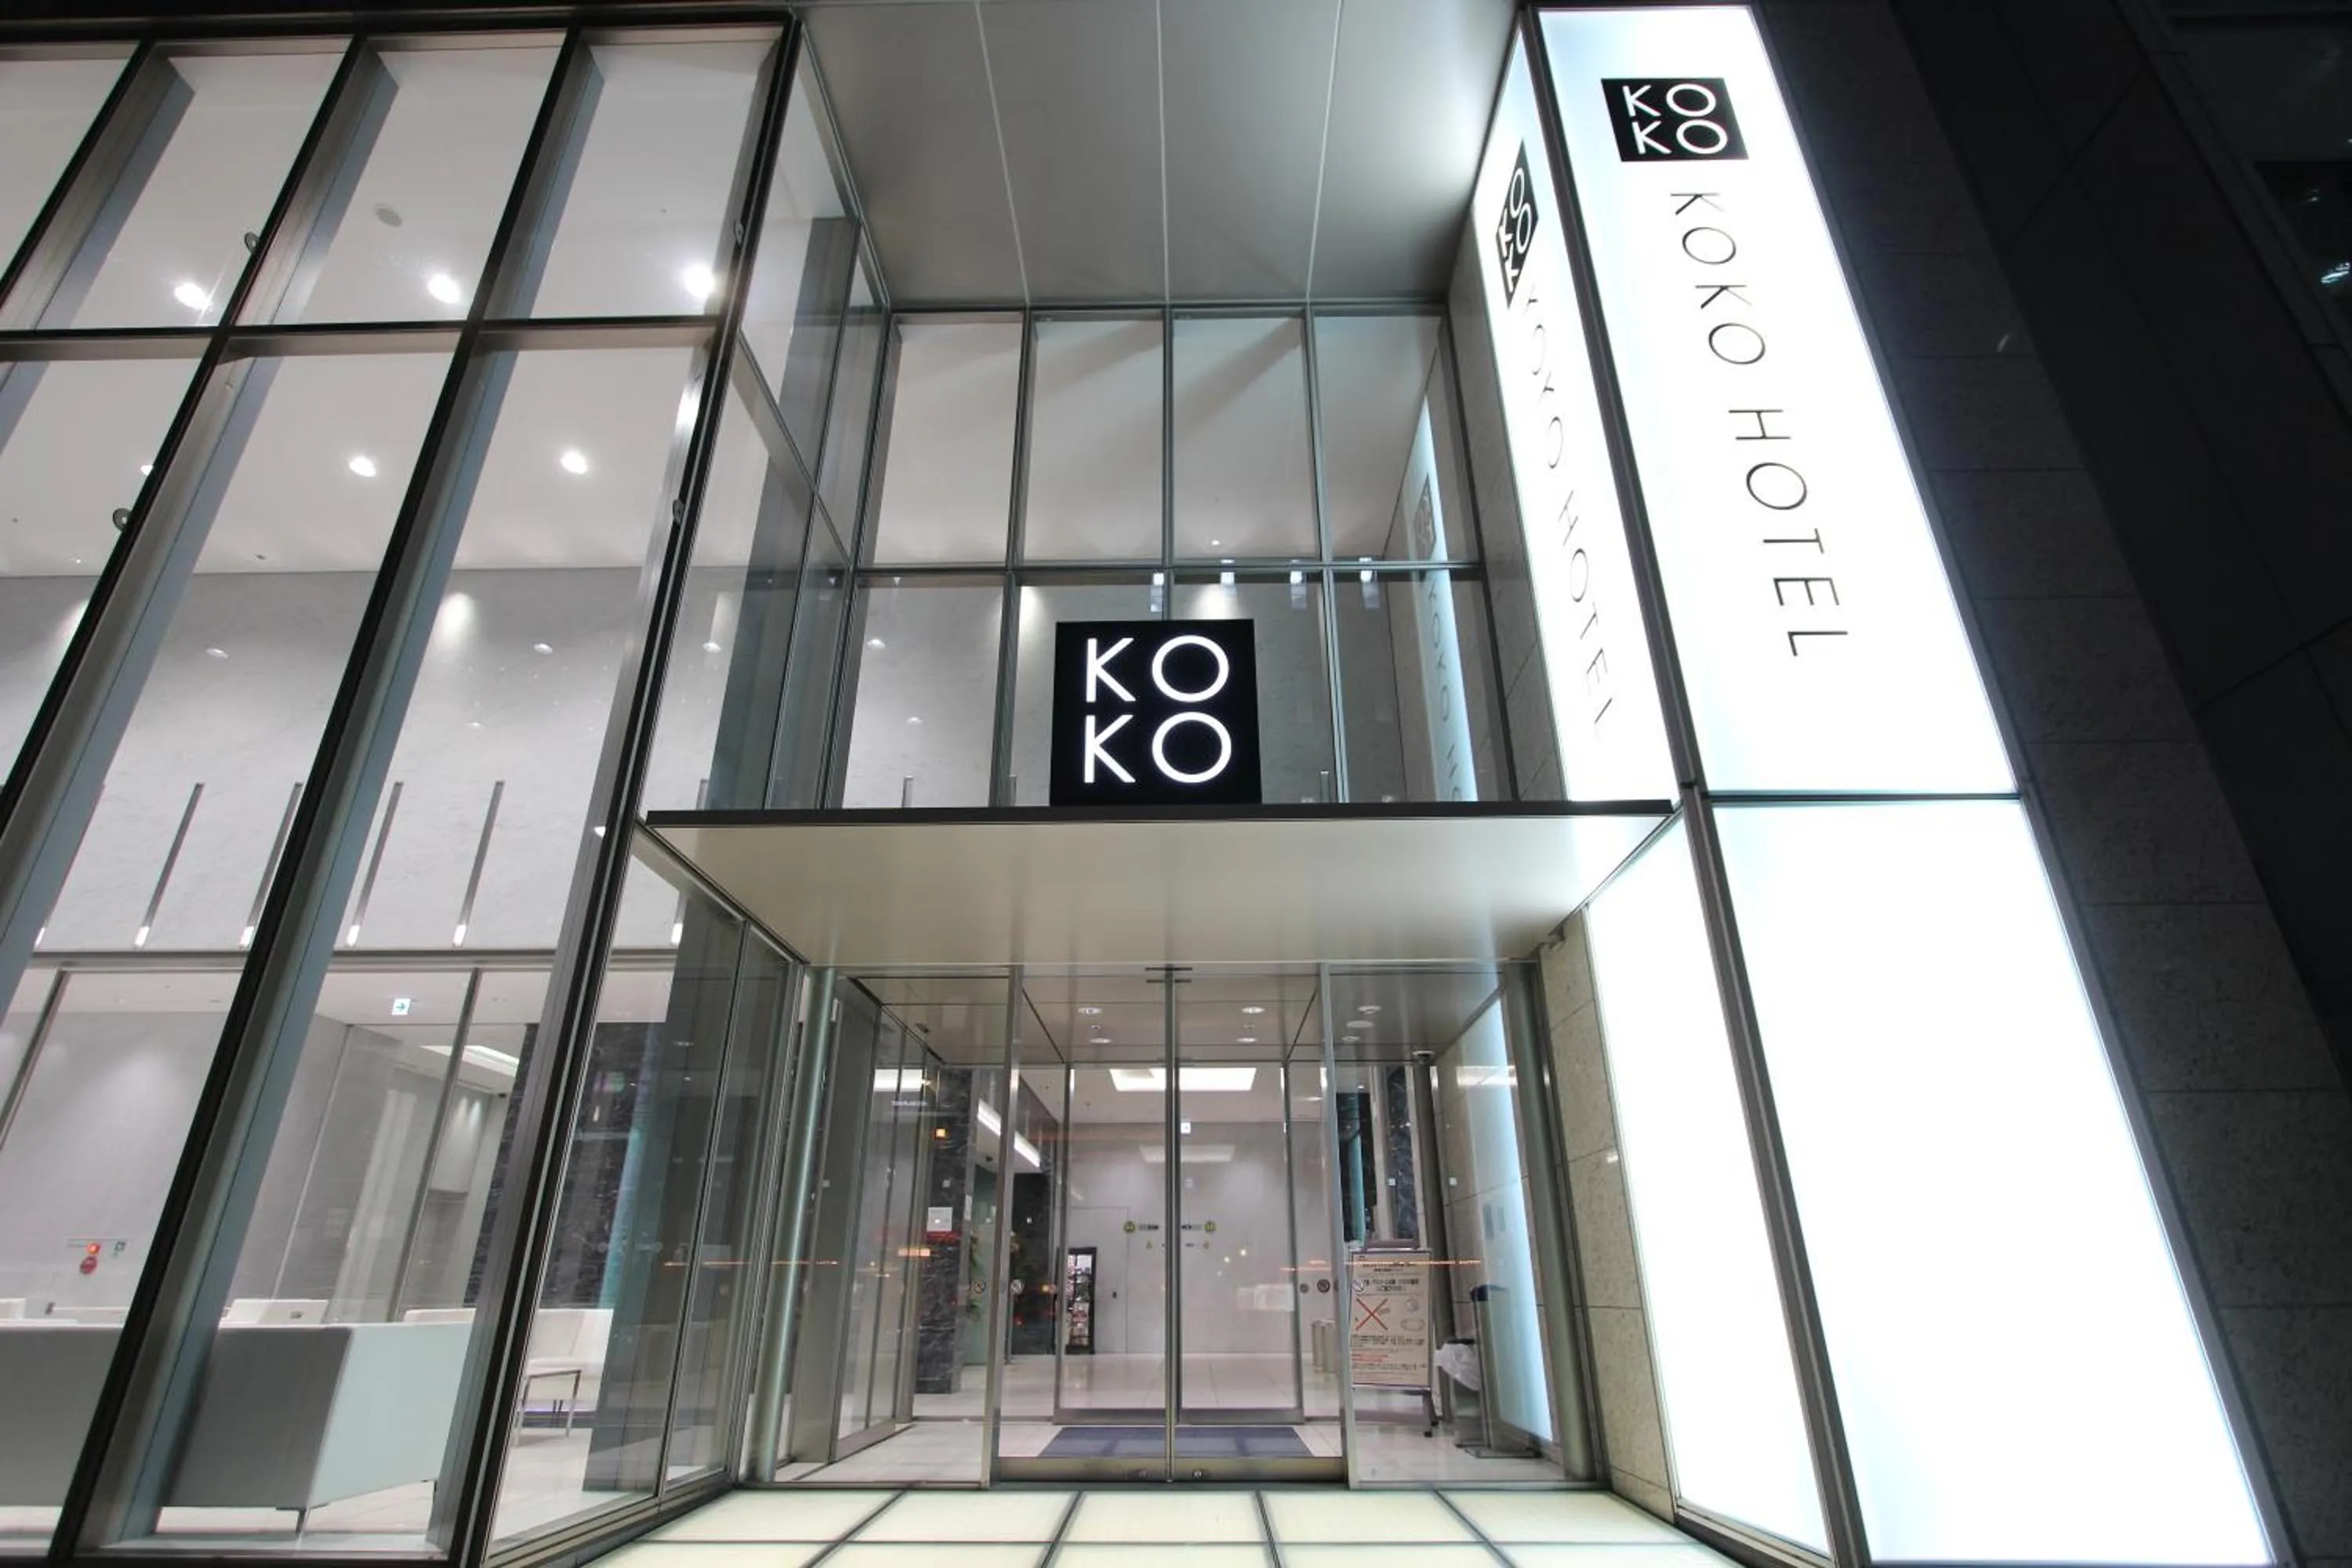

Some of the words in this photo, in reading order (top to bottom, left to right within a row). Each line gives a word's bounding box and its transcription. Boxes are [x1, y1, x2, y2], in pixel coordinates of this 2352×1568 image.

[1622, 82, 1717, 117] KO
[1632, 118, 1728, 156] KO
[1670, 192, 1766, 365] KOKO
[1728, 409, 1849, 656] HOTEL
[1522, 282, 1564, 470] KOKO
[1558, 489, 1613, 742] HOTEL
[1085, 633, 1230, 703] KO
[1083, 710, 1232, 784] KO
